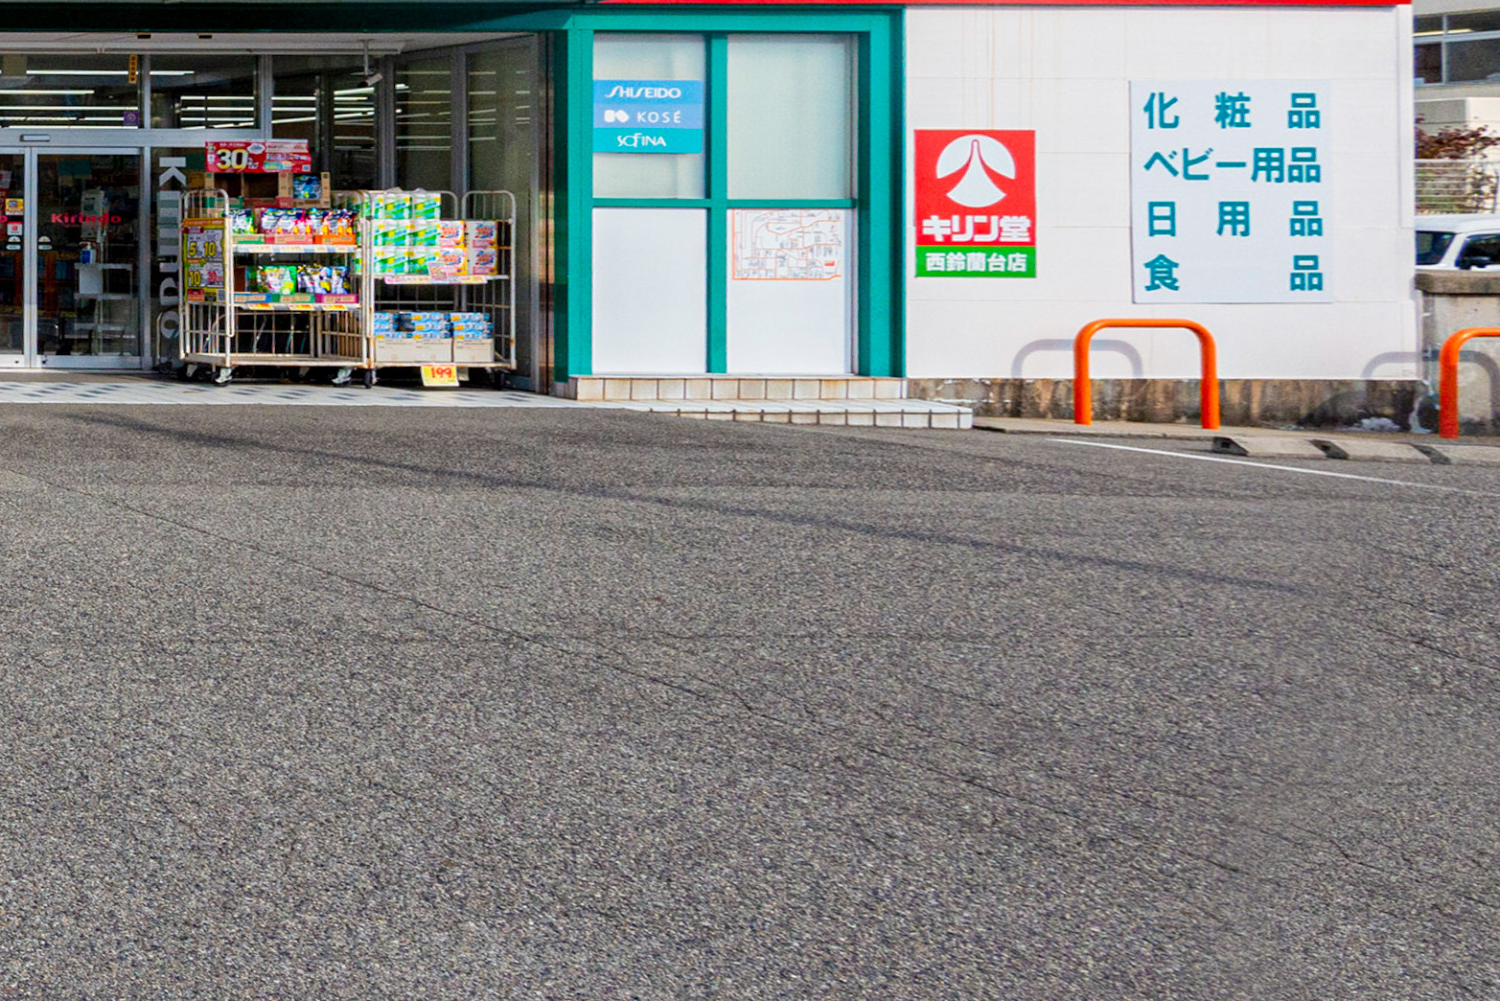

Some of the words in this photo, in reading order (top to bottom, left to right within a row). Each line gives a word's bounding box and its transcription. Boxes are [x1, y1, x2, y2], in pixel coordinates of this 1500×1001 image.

[604, 85, 682, 99] SHISEIDO
[636, 110, 682, 124] KOSÉ
[1143, 91, 1321, 130] 化粧品
[616, 132, 667, 148] SOFINA
[216, 148, 248, 170] 30
[1143, 146, 1322, 184] ベビー用品
[51, 212, 122, 223] Kirindo
[921, 214, 1032, 242] キリン堂
[1147, 200, 1324, 237] 日用品
[925, 252, 1027, 272] 西鈴蘭台店
[1143, 253, 1324, 292] 食品
[431, 367, 453, 378] 199
